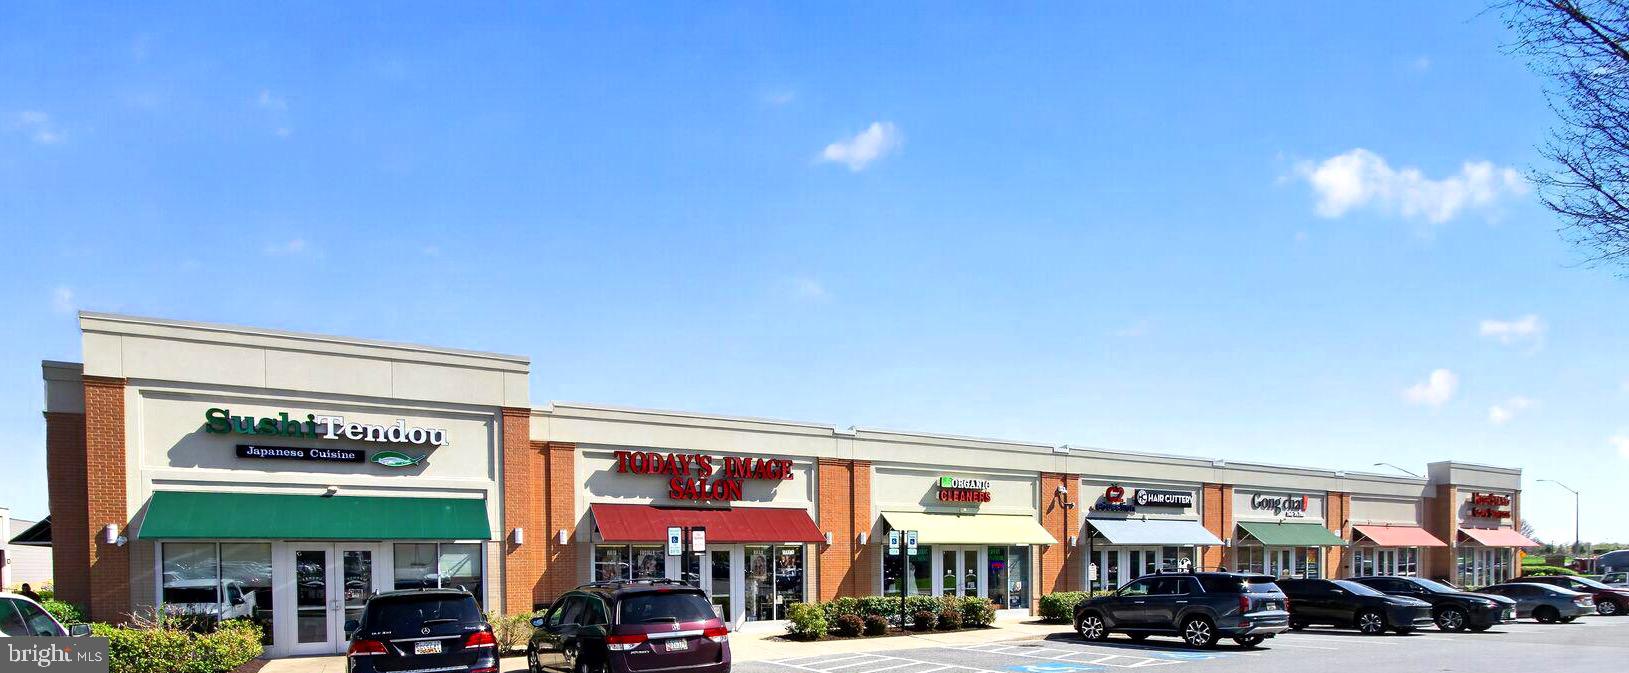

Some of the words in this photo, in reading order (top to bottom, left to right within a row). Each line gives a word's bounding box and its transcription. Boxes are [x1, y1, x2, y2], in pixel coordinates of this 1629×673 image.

[246, 446, 304, 458] Japanese
[310, 449, 355, 459] Cuisine
[614, 450, 713, 478] TODAY'S
[723, 456, 794, 481] IMAGE
[669, 476, 743, 501] SALON
[951, 478, 991, 490] ORGANIC
[939, 489, 992, 503] CLEANERS
[1148, 493, 1164, 503] HAIR
[1165, 494, 1193, 505] CUTTERY
[1251, 493, 1281, 516] Gong
